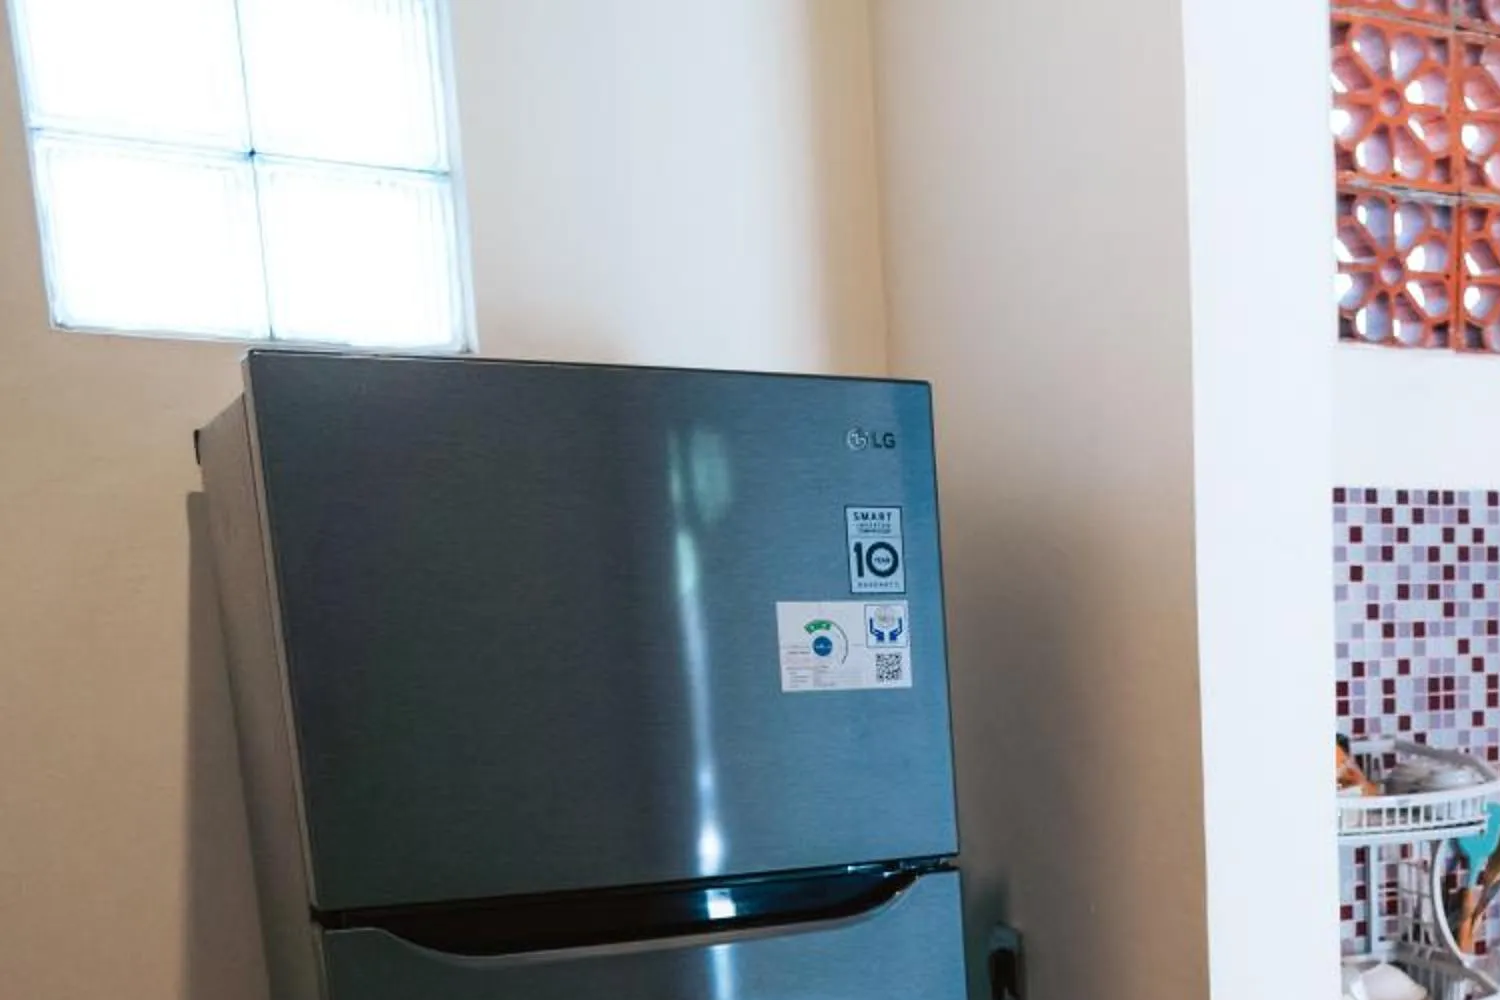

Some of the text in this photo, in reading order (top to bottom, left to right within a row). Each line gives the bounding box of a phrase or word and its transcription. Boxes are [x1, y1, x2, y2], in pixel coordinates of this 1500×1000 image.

[872, 431, 896, 449] LG
[853, 511, 892, 521] SMART
[853, 541, 899, 578] 10
